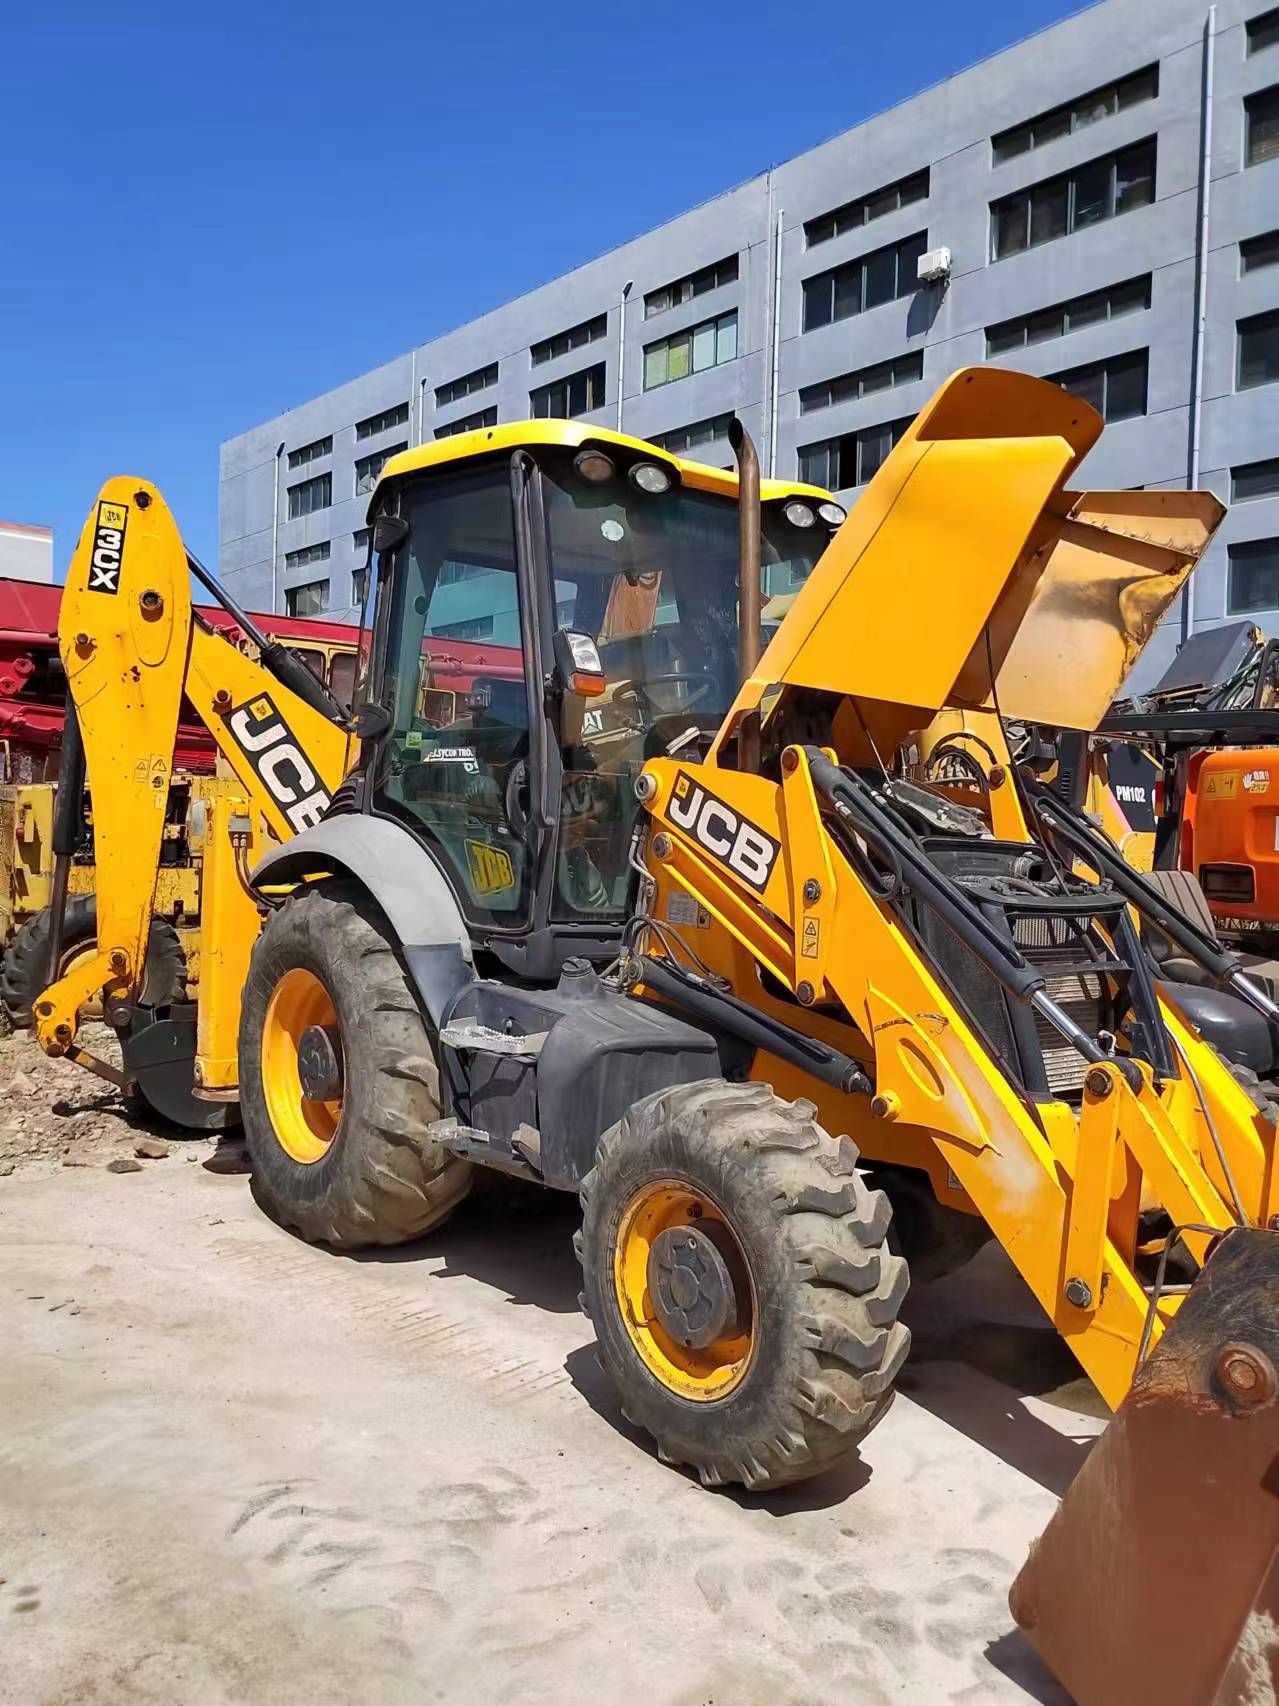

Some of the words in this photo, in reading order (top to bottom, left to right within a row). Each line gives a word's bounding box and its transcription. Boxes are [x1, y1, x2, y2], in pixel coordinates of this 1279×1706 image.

[89, 528, 122, 590] 3CX
[581, 709, 604, 734] AT
[1115, 785, 1147, 803] PM102
[670, 787, 774, 886] JCB
[471, 845, 512, 890] JCB
